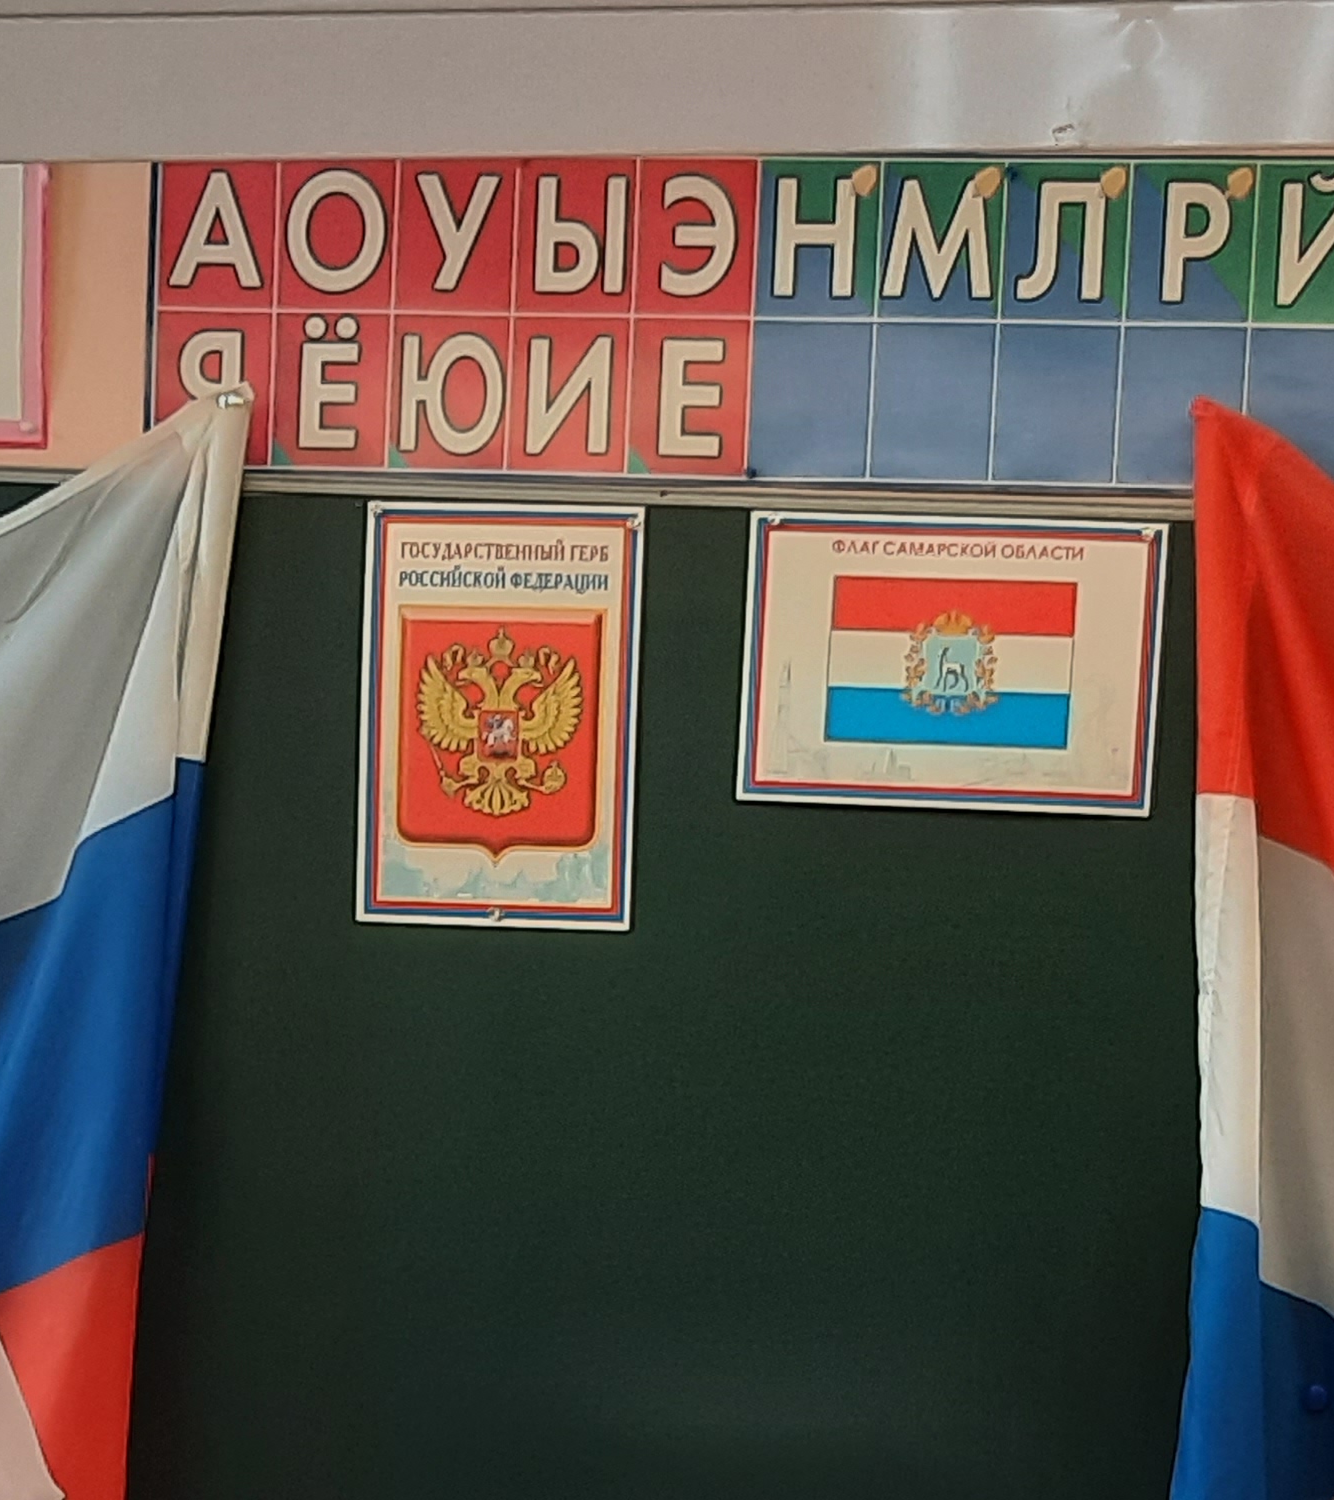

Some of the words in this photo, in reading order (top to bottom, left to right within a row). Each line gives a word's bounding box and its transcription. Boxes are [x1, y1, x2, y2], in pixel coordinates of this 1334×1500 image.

[167, 169, 263, 289] А
[285, 168, 388, 293] О
[416, 172, 503, 291] У
[533, 174, 631, 294] Ы
[659, 173, 738, 298] Э
[771, 177, 858, 299] Н
[880, 178, 993, 300] М
[1014, 180, 1107, 302] Л
[1160, 181, 1233, 304] Р
[297, 314, 361, 451] Ё
[397, 332, 507, 456] Ю
[523, 335, 614, 456] И
[657, 337, 726, 458] Е
[400, 539, 566, 562] ГОСУДАРСТВЕННЫЙ
[569, 544, 610, 563] ГЕРБ
[831, 539, 880, 555] ФЛАГ
[883, 540, 997, 559] САМАРСКОЙ
[1001, 543, 1085, 561] ОБЛАСТИ
[398, 565, 507, 590] РОССИЙСКОЙ
[509, 571, 610, 594] ФЕДЕРАЦИИ
